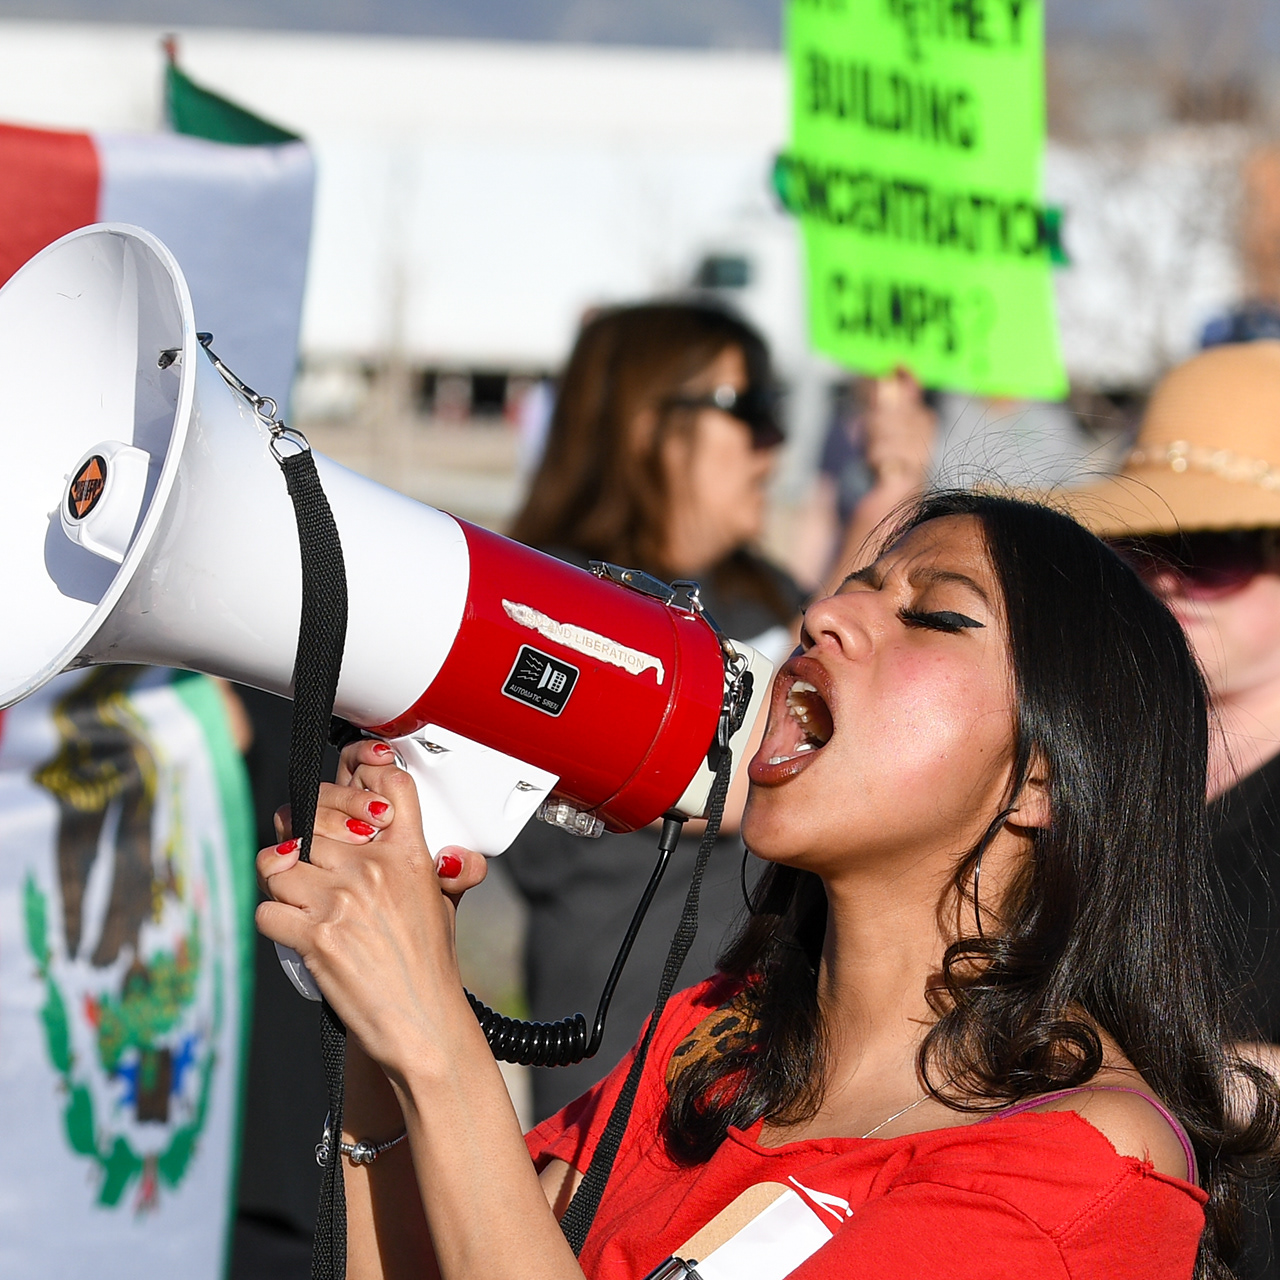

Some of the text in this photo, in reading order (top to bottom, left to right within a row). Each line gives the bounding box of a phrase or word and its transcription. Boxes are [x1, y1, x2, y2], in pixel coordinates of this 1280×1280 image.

[805, 46, 980, 150] BUILDING
[575, 634, 645, 669] LIBERATION
[509, 684, 559, 710] AUTOMATIC SIREN
